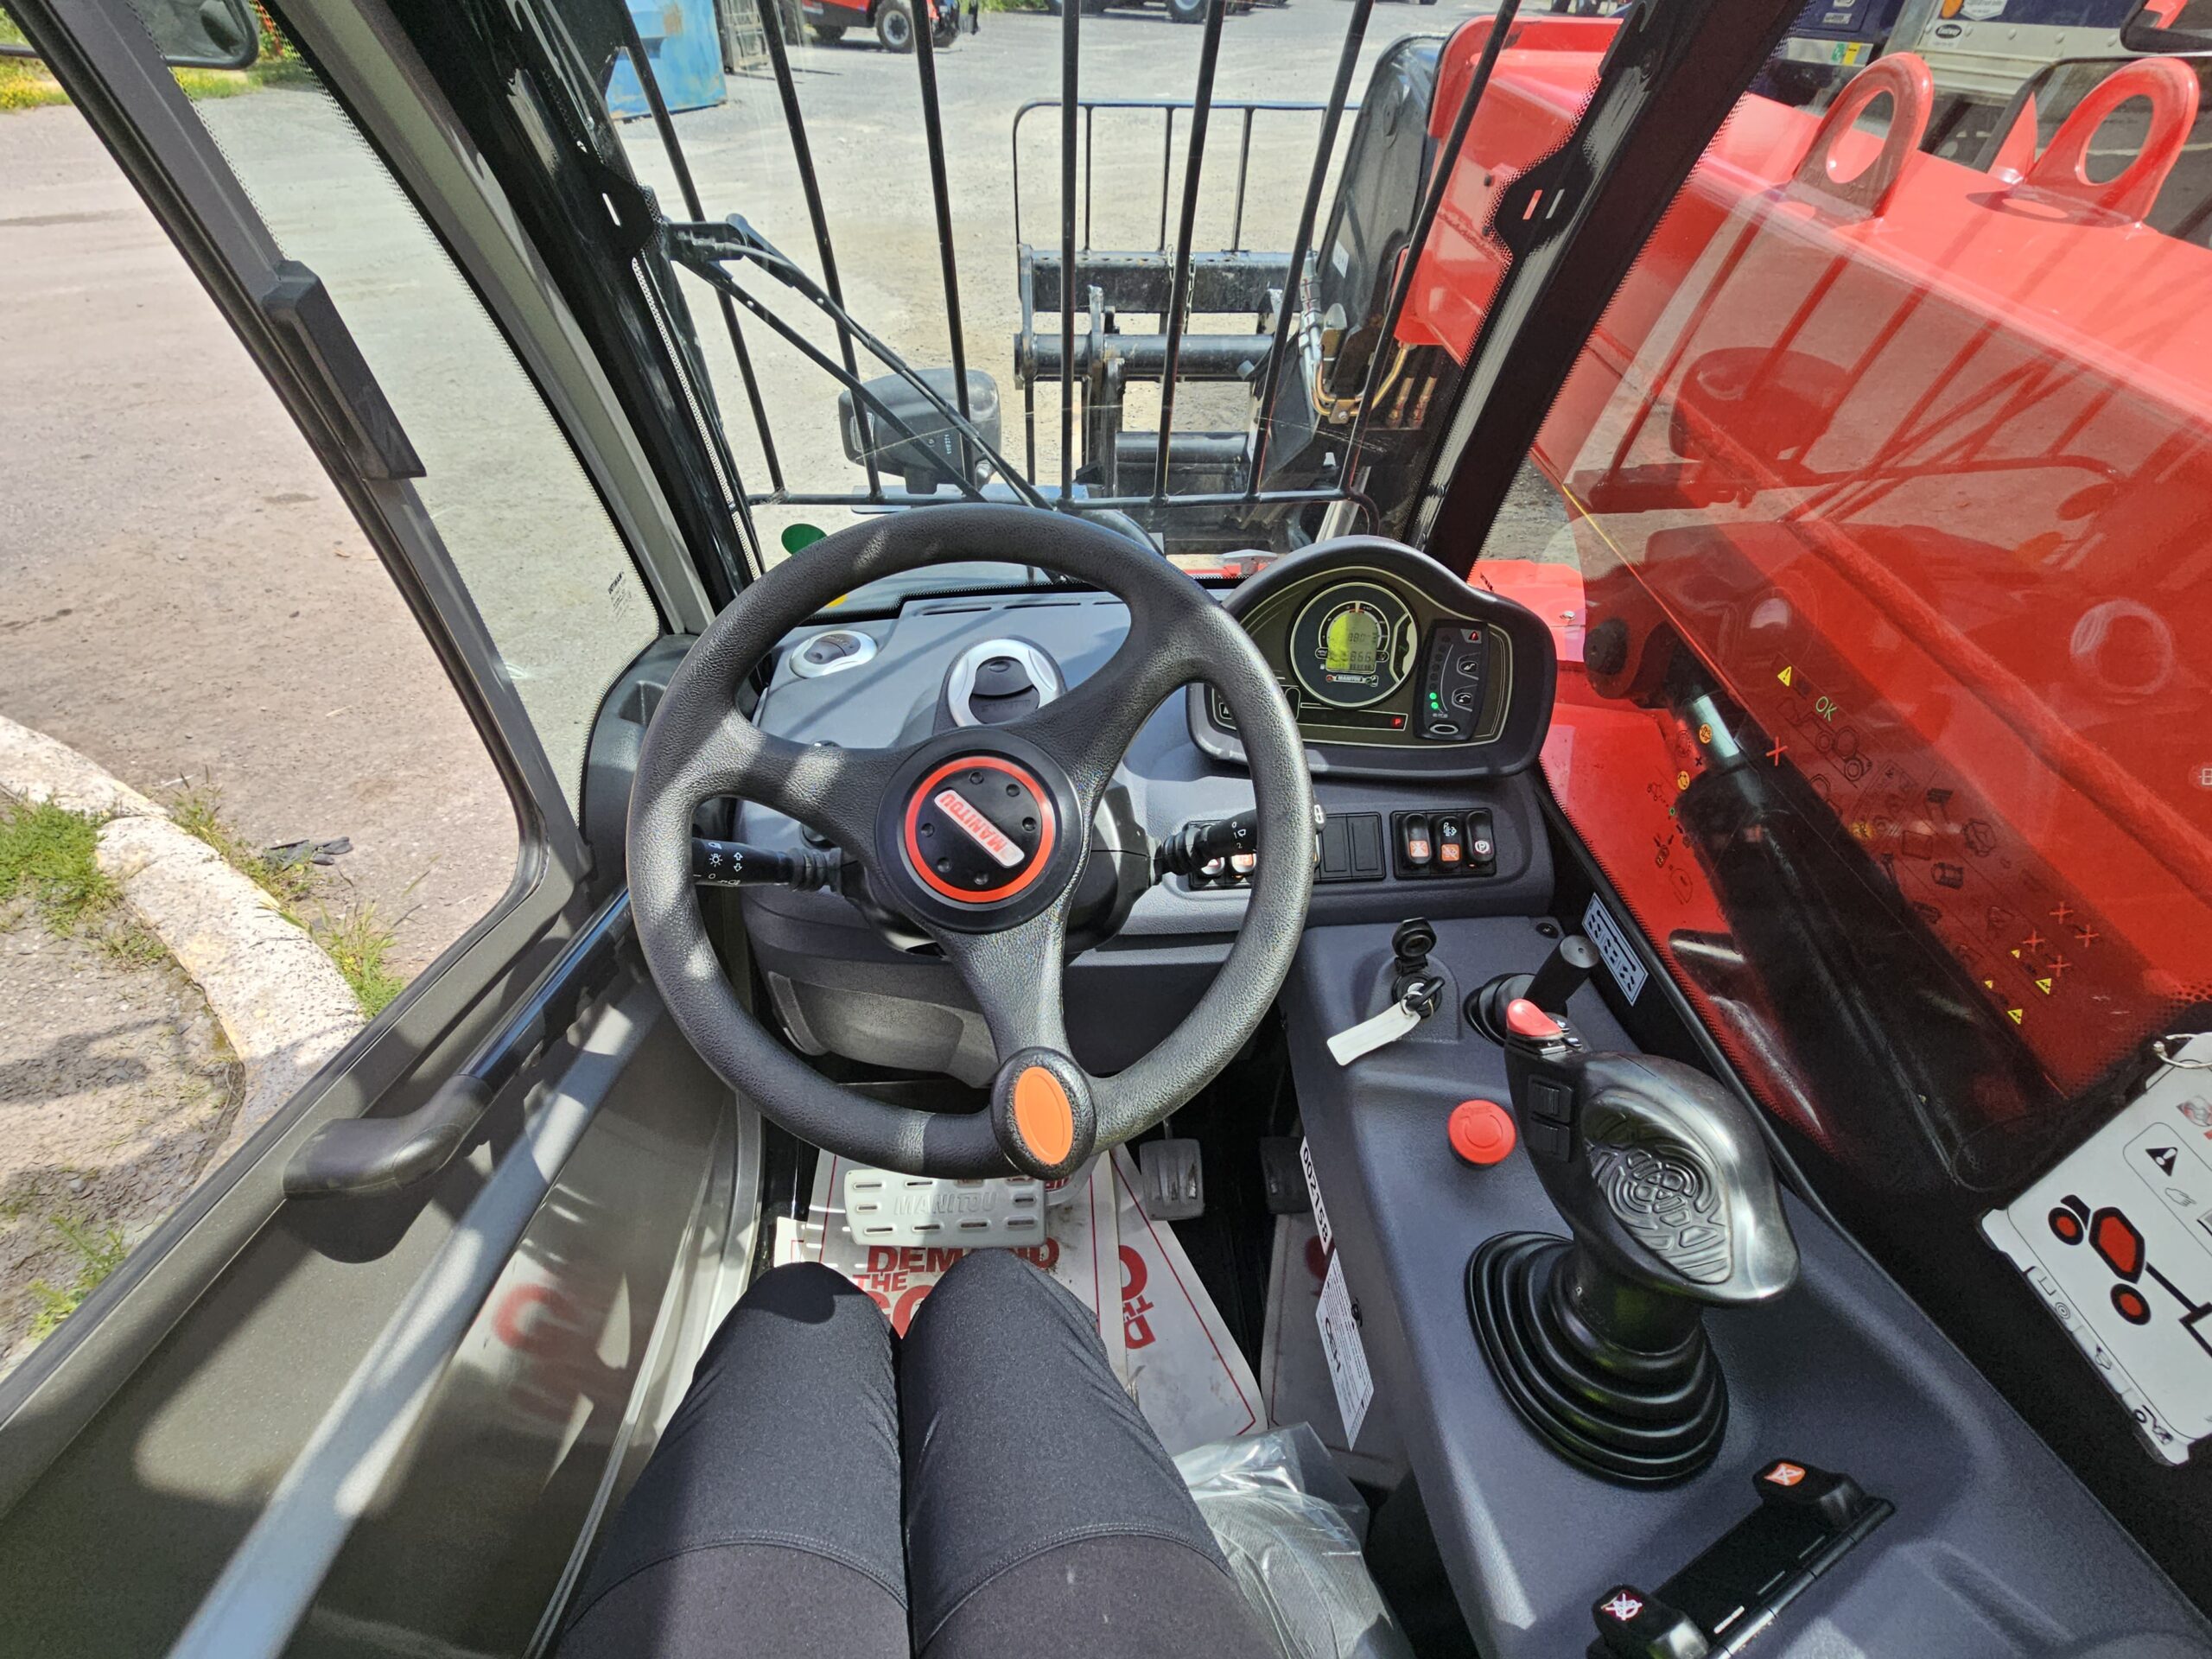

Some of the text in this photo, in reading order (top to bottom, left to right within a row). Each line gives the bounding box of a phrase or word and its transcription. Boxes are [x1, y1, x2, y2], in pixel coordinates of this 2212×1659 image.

[1815, 696, 1837, 721] OK
[939, 792, 1007, 853] MANITOU
[893, 1192, 996, 1215] MANITOU
[1302, 1146, 1329, 1244] 002158
